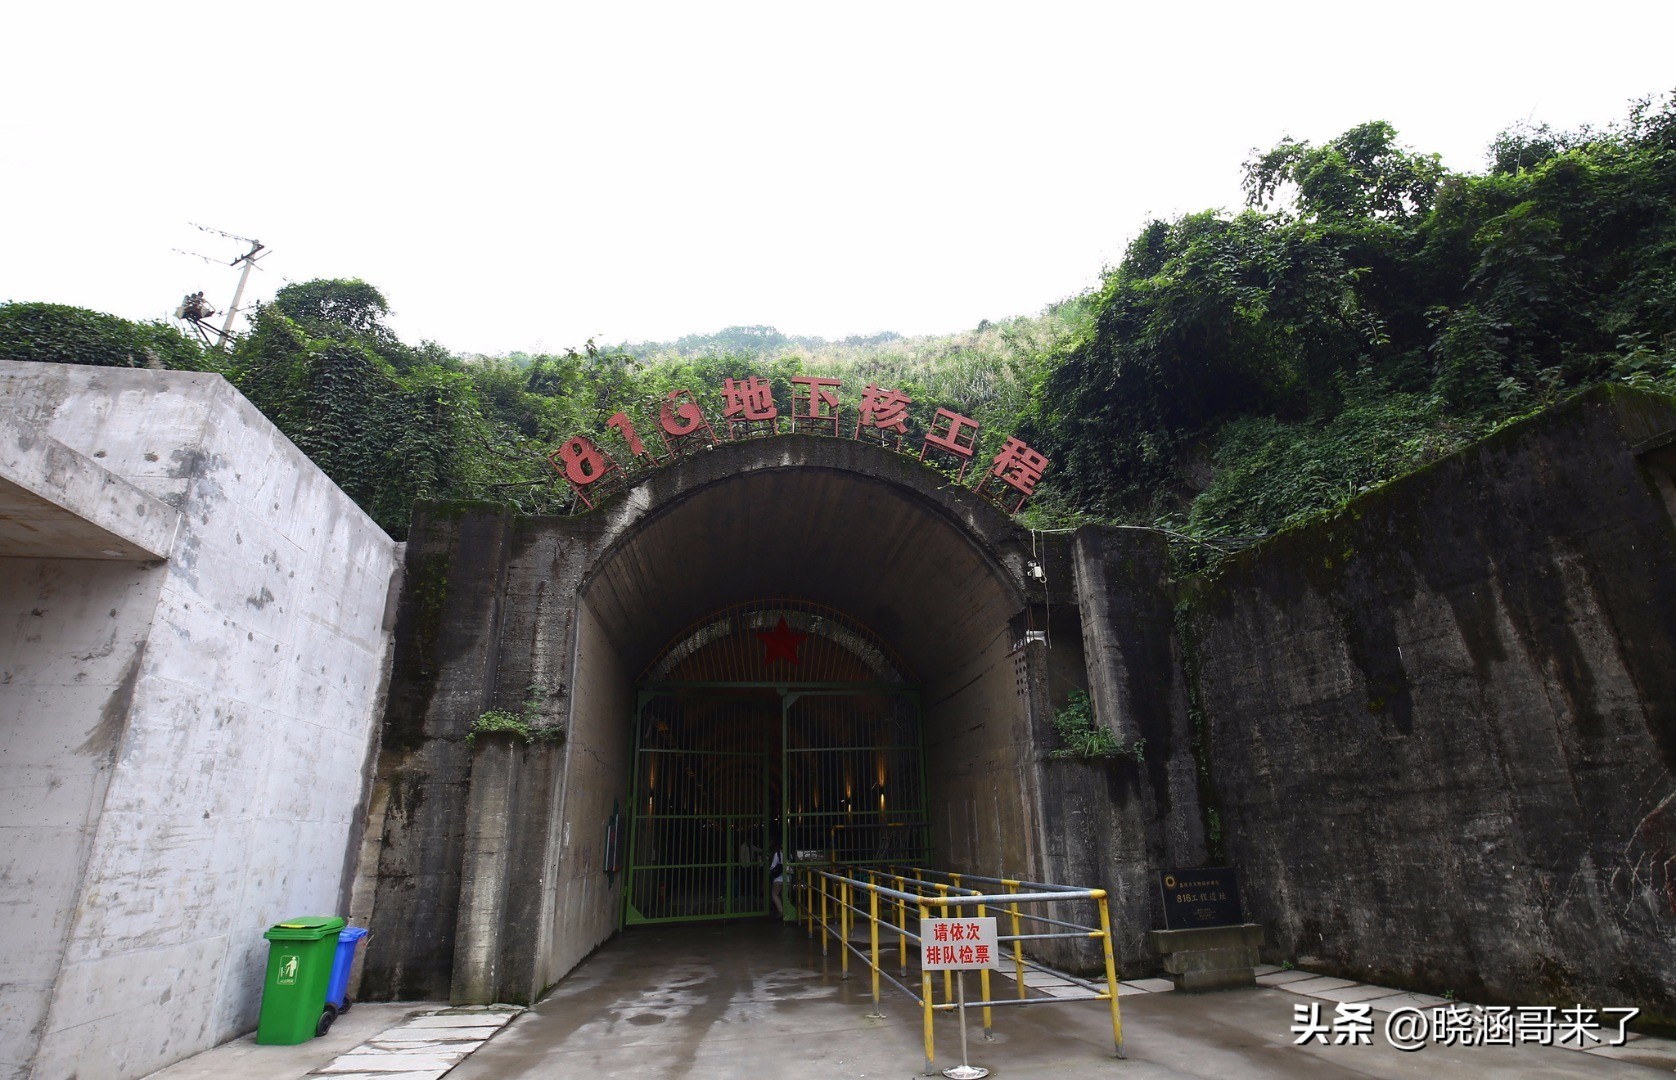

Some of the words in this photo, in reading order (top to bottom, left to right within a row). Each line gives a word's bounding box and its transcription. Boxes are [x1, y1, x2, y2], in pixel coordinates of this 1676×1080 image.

[559, 375, 1049, 496] 816地下核工程
[933, 923, 981, 941] 请依次
[926, 945, 990, 964] 排队检票
